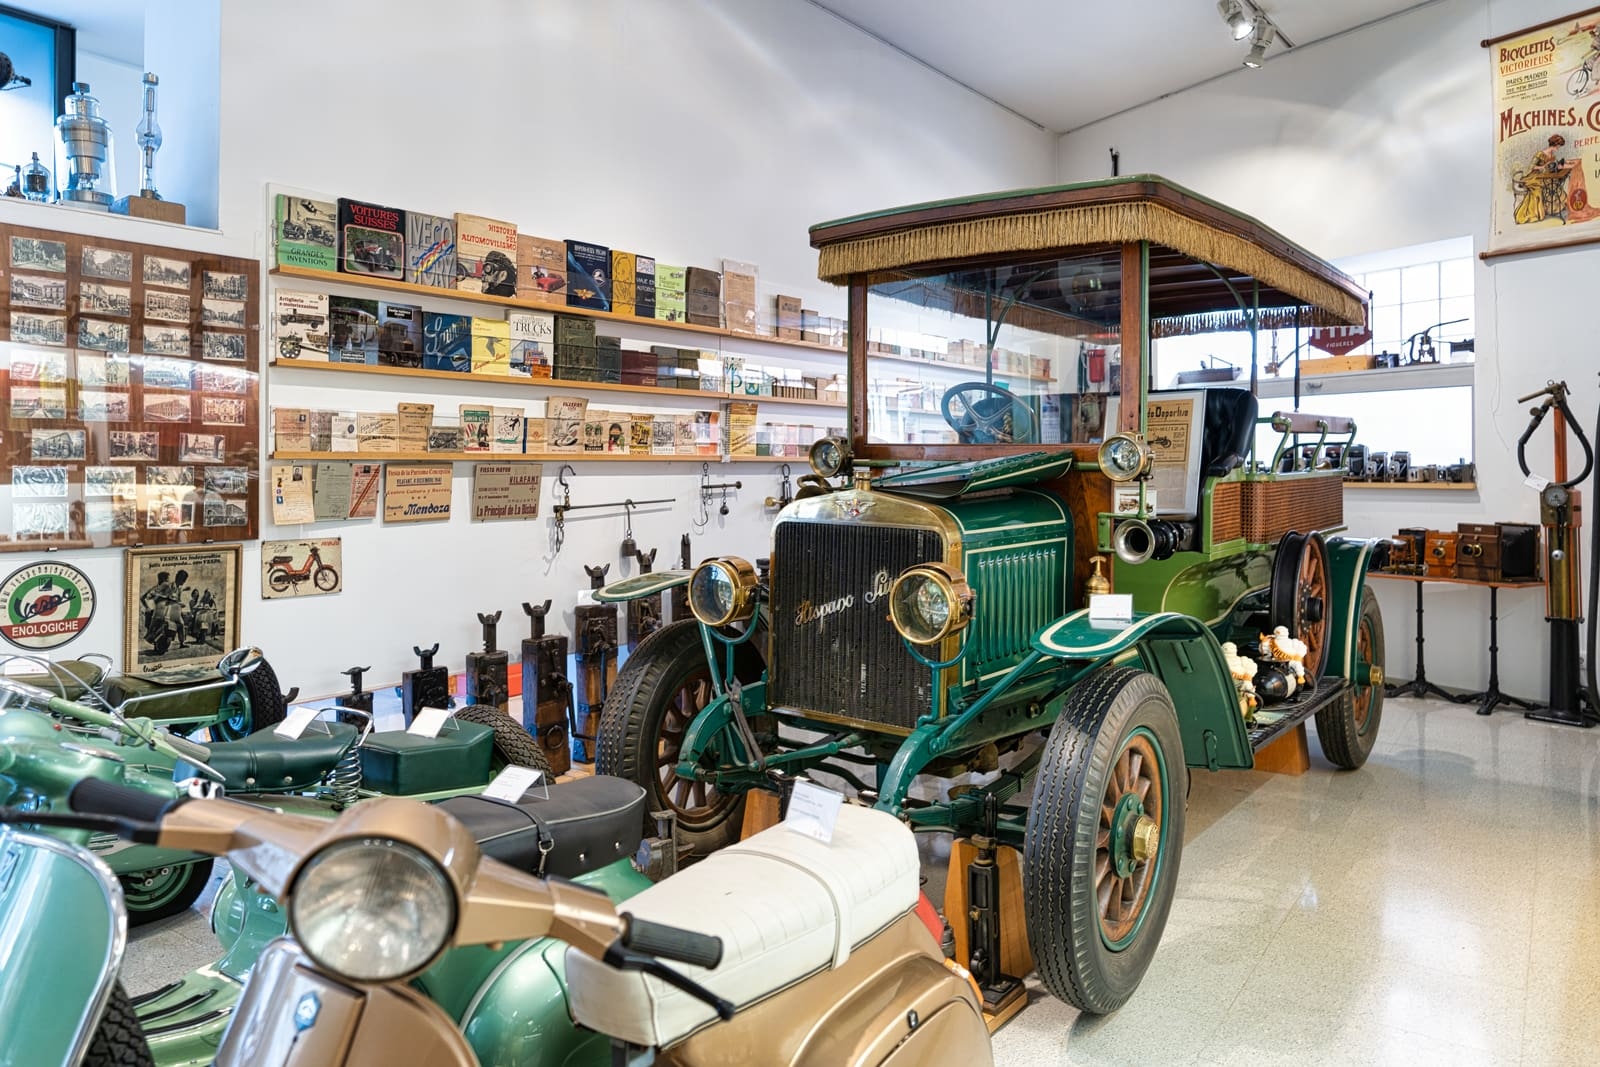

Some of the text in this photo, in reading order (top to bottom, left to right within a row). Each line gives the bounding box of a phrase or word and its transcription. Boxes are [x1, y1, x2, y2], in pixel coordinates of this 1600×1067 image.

[1574, 136, 1600, 147] PERFE
[350, 204, 399, 221] VOITURES
[354, 214, 397, 230] SUISSES
[488, 224, 517, 236] HISTORIA
[461, 233, 517, 251] AUTOMOVILISMO
[287, 255, 328, 267] INVENTIONS
[514, 320, 552, 335] TRUCKS
[509, 476, 538, 485] VILAFANT
[403, 503, 450, 515] Mendoza
[795, 594, 854, 631] Hispano
[12, 621, 78, 637] ENOLOGICHE
